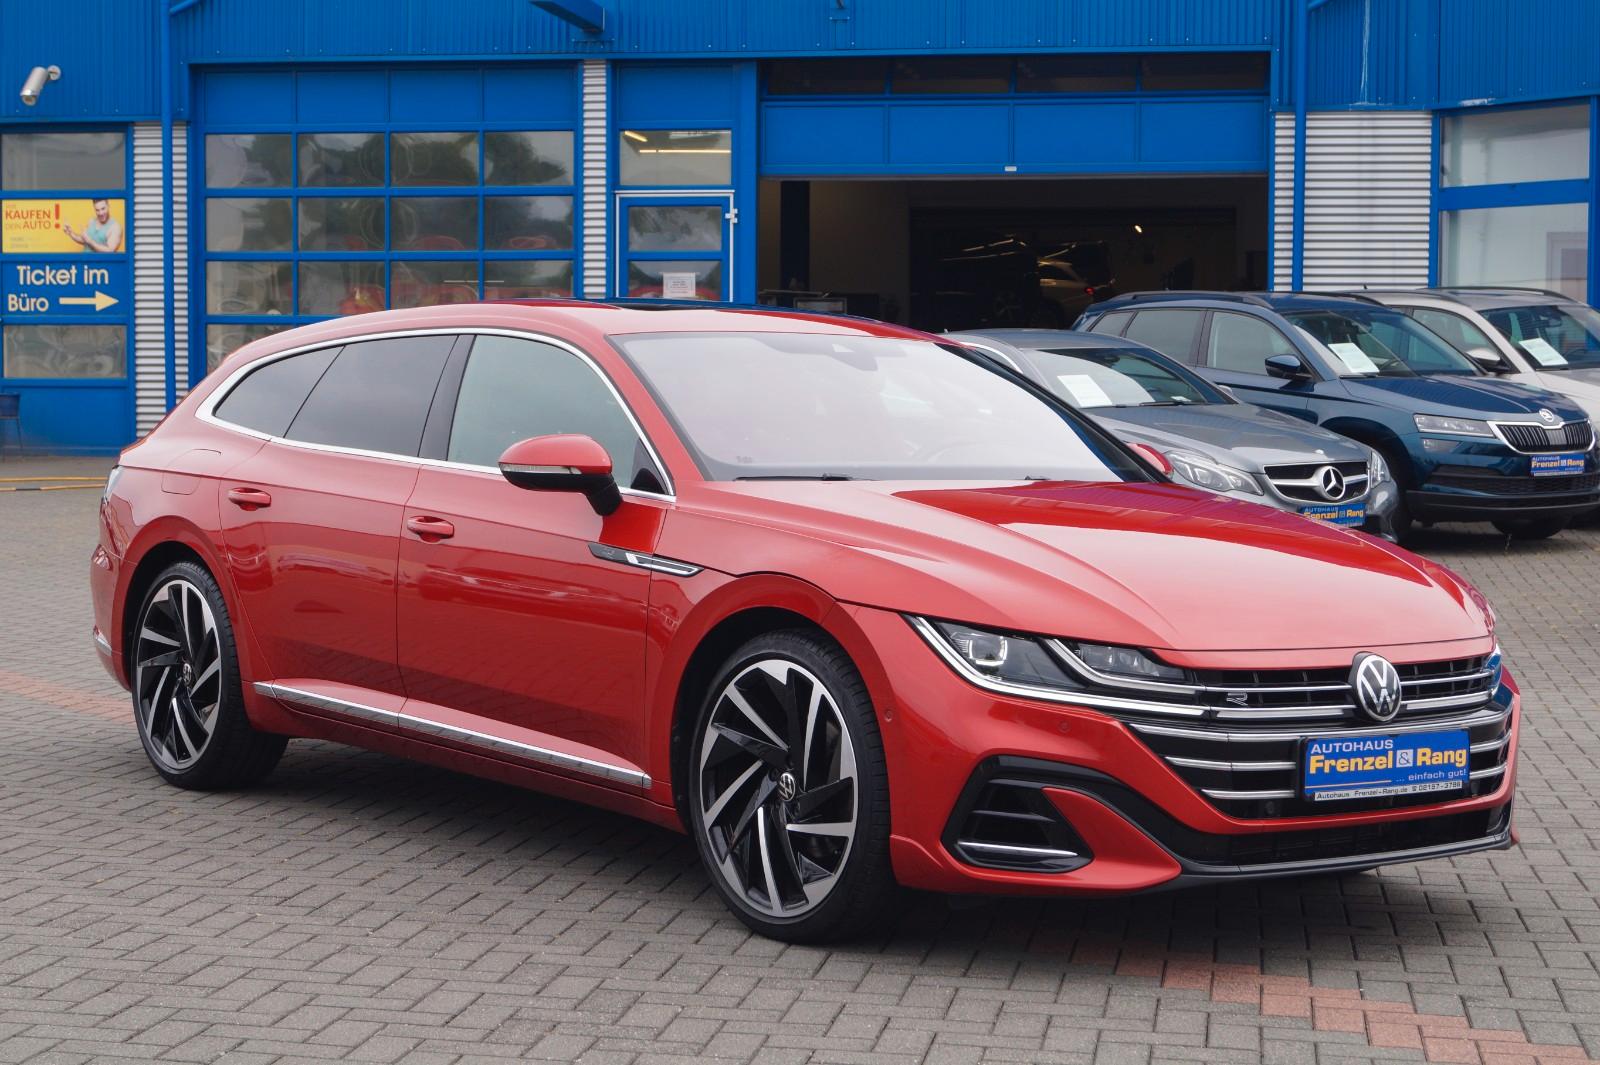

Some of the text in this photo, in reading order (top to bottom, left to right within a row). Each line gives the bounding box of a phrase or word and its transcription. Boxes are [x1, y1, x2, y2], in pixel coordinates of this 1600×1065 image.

[5, 209, 51, 220] KAUFEN
[22, 220, 51, 230] AUTO
[16, 265, 109, 285] Ticket im
[8, 293, 49, 312] Büro
[1347, 509, 1364, 518] Rang
[1311, 740, 1393, 754] AUTOHAUS
[1309, 748, 1467, 774] Frenzel & Rang
[1408, 771, 1445, 782] einfach
[1448, 769, 1467, 779] gut!
[1316, 791, 1350, 800] Autohaus
